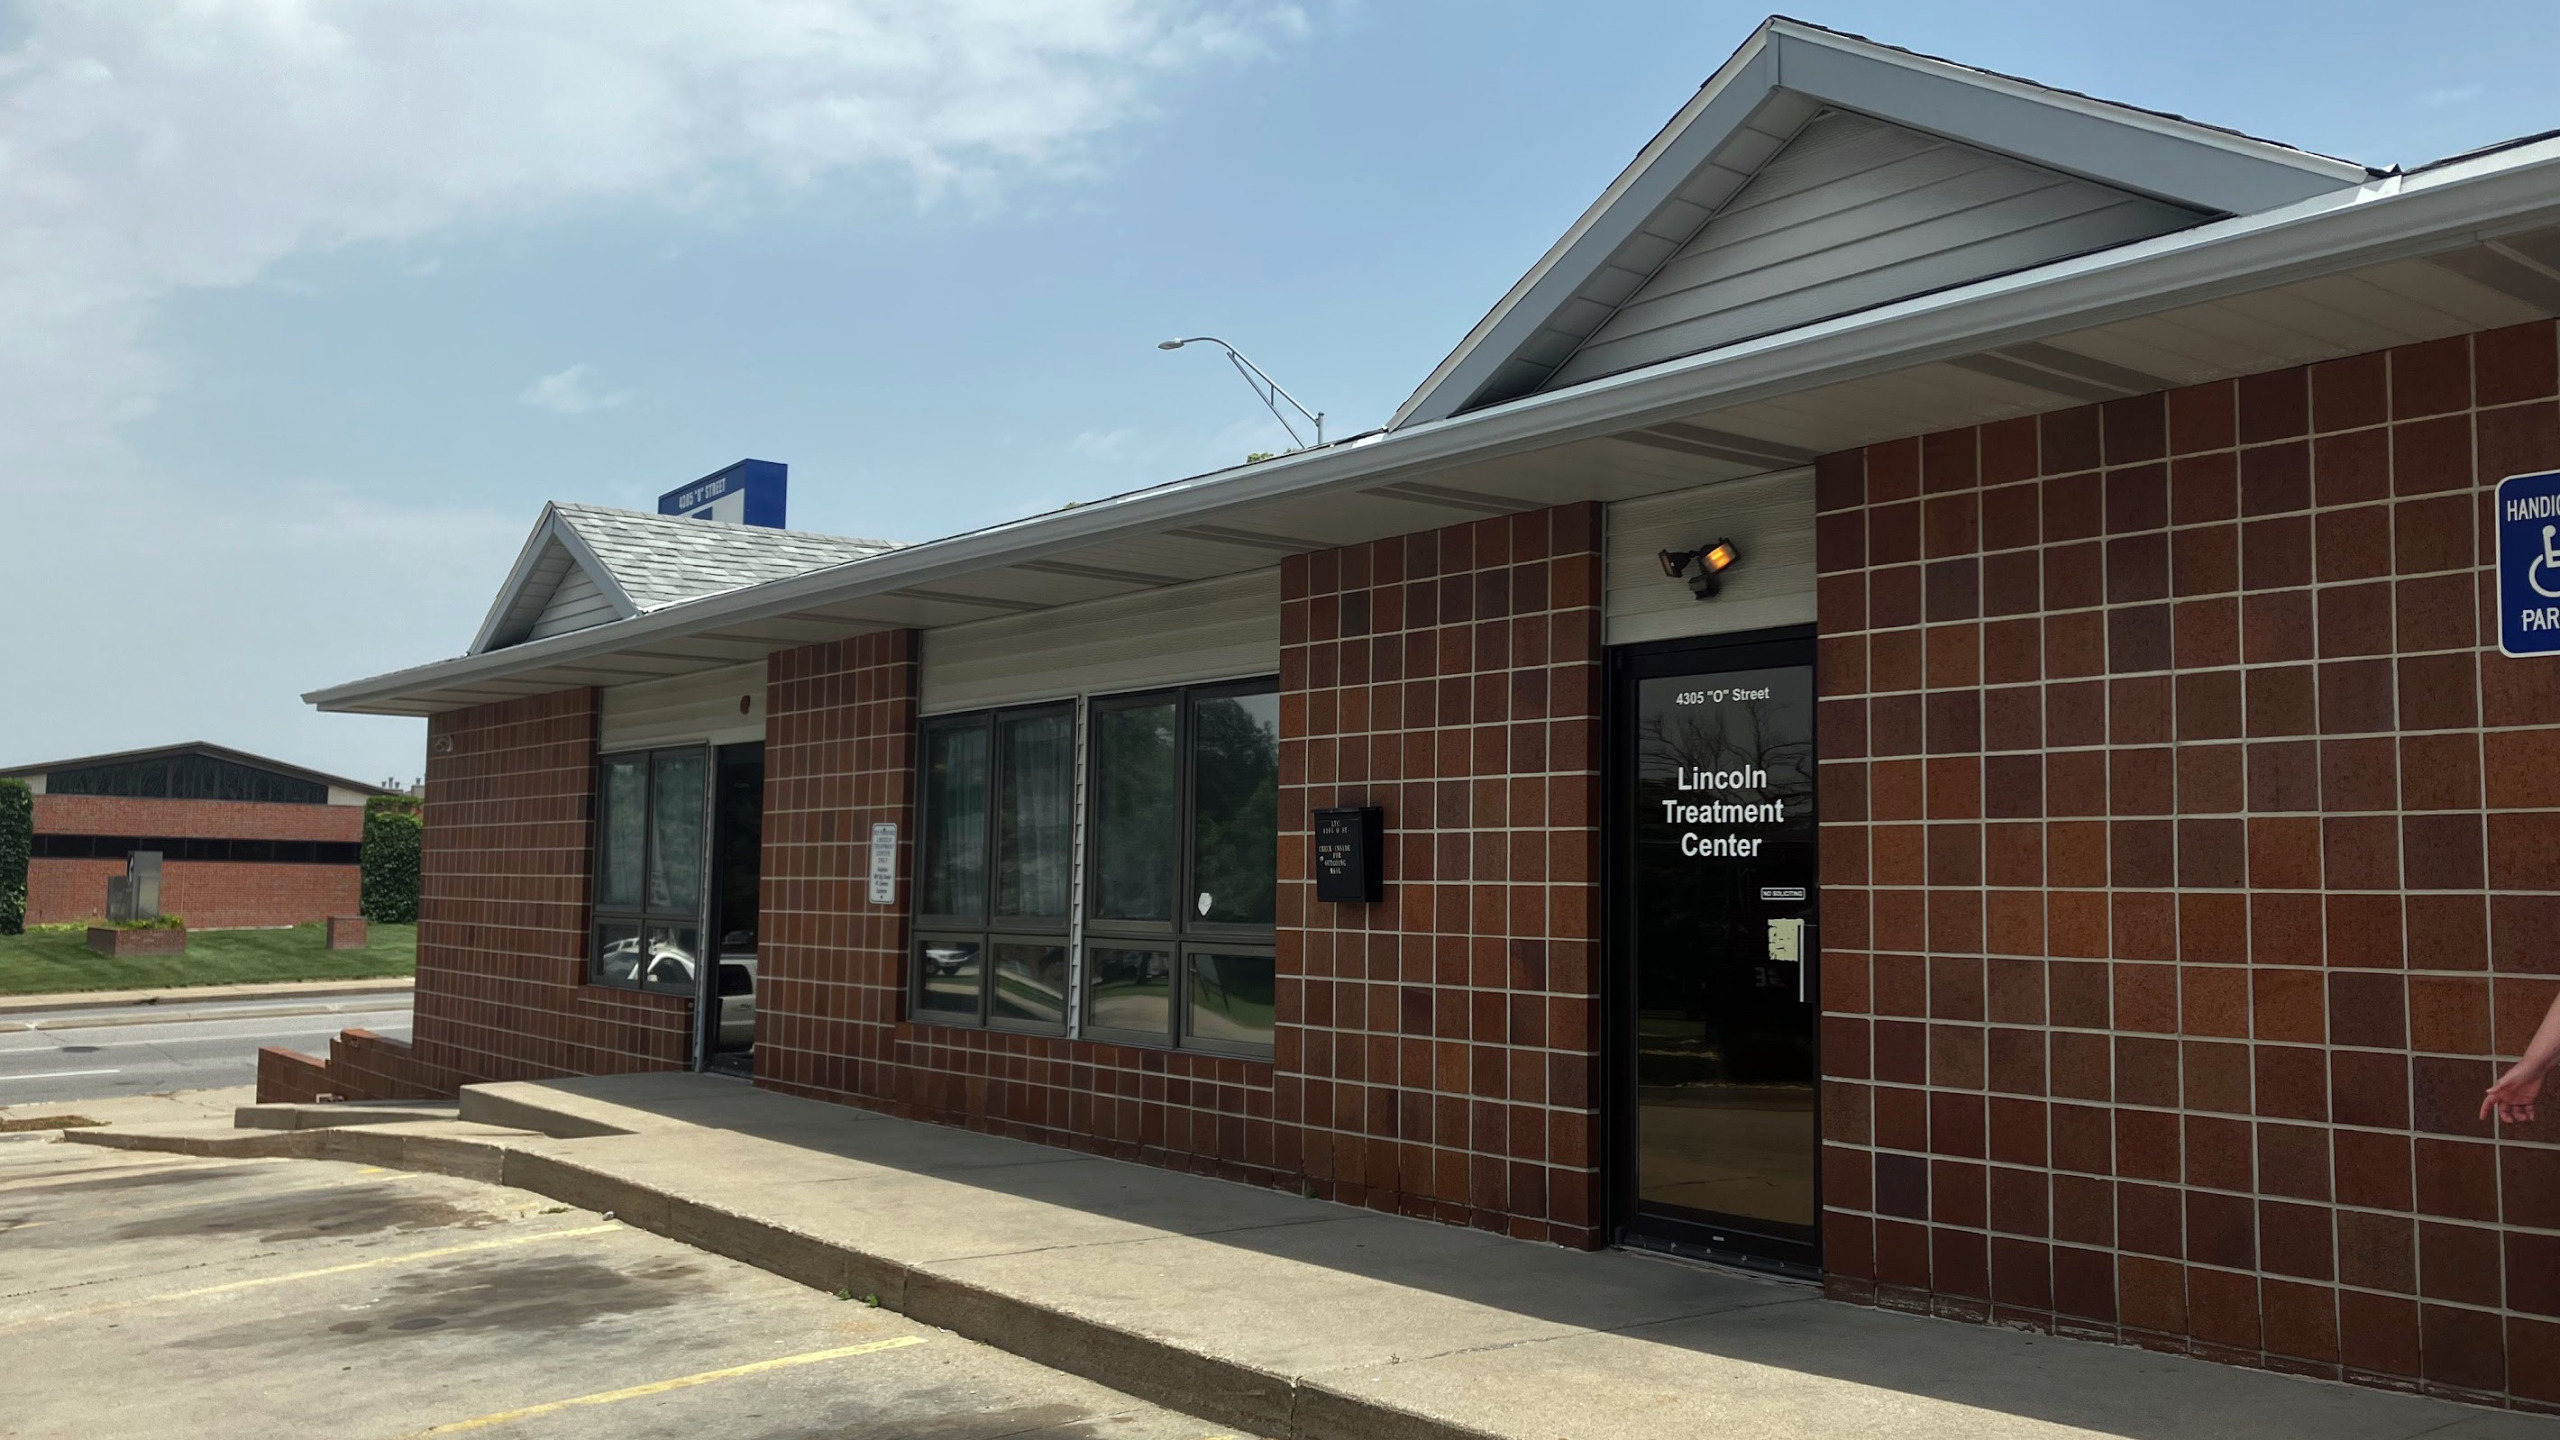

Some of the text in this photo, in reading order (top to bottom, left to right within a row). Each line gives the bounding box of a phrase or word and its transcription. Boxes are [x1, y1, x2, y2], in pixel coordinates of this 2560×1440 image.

[705, 478, 726, 499] STREET
[1675, 687, 1770, 705] 4305 "O" Street
[1677, 764, 1767, 790] Lincoln
[1662, 799, 1784, 823] Treatment
[1681, 832, 1762, 857] Center
